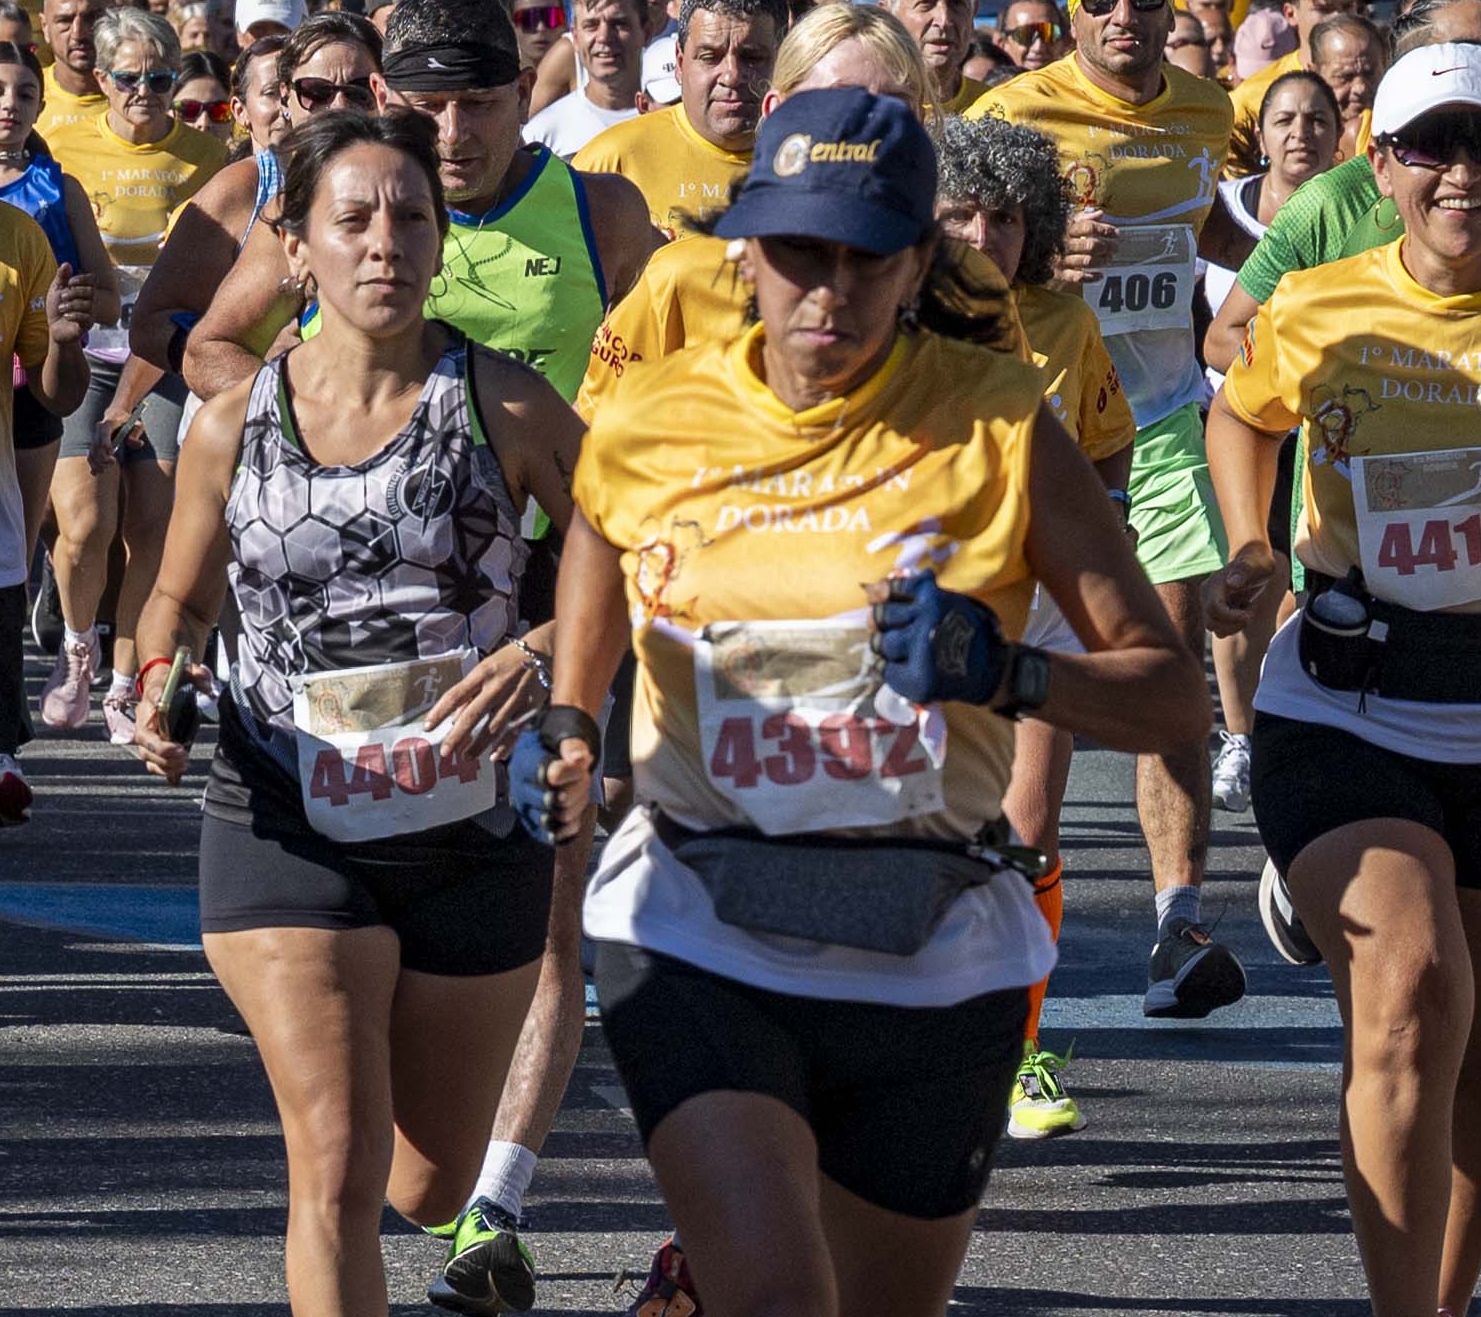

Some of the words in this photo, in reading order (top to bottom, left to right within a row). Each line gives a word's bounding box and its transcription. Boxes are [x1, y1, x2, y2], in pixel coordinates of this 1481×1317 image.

[773, 133, 882, 177] Central
[1109, 143, 1187, 159] DORADA
[524, 256, 562, 278] NEJ
[1099, 271, 1178, 314] 406
[1359, 345, 1383, 367] 1°
[715, 503, 872, 534] DORADA
[710, 713, 928, 789] 4392
[309, 736, 481, 807] 4404
